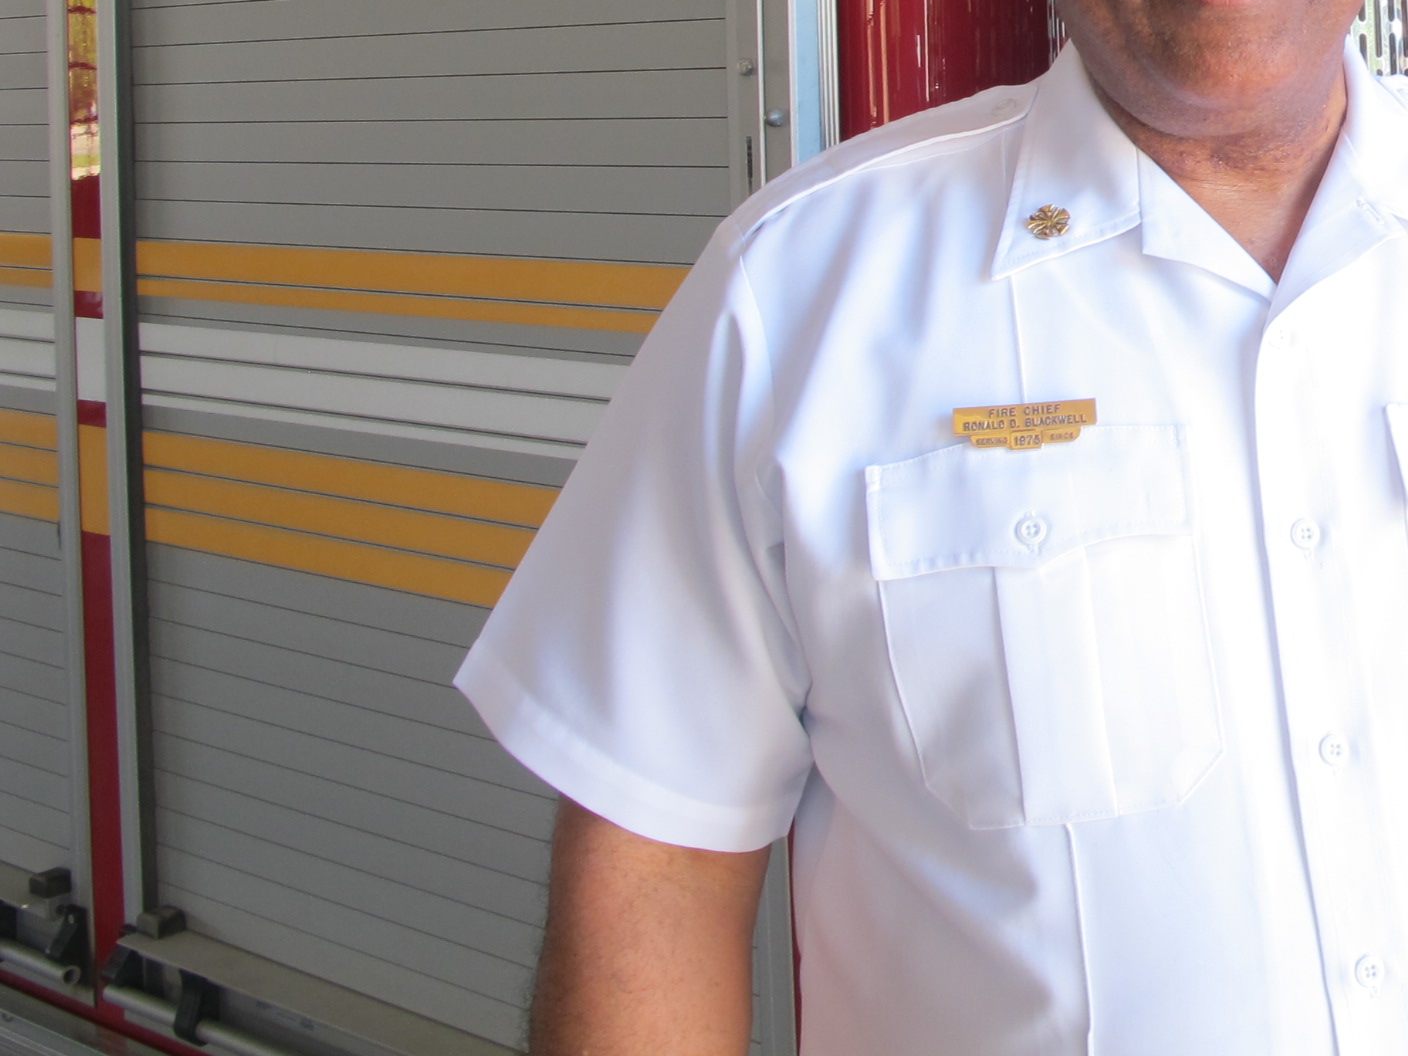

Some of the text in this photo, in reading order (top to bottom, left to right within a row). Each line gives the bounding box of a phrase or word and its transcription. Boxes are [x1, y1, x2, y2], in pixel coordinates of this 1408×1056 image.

[988, 404, 1061, 419] FIRE CHIEF
[963, 414, 1087, 432] RONALD D. BLACKWELL
